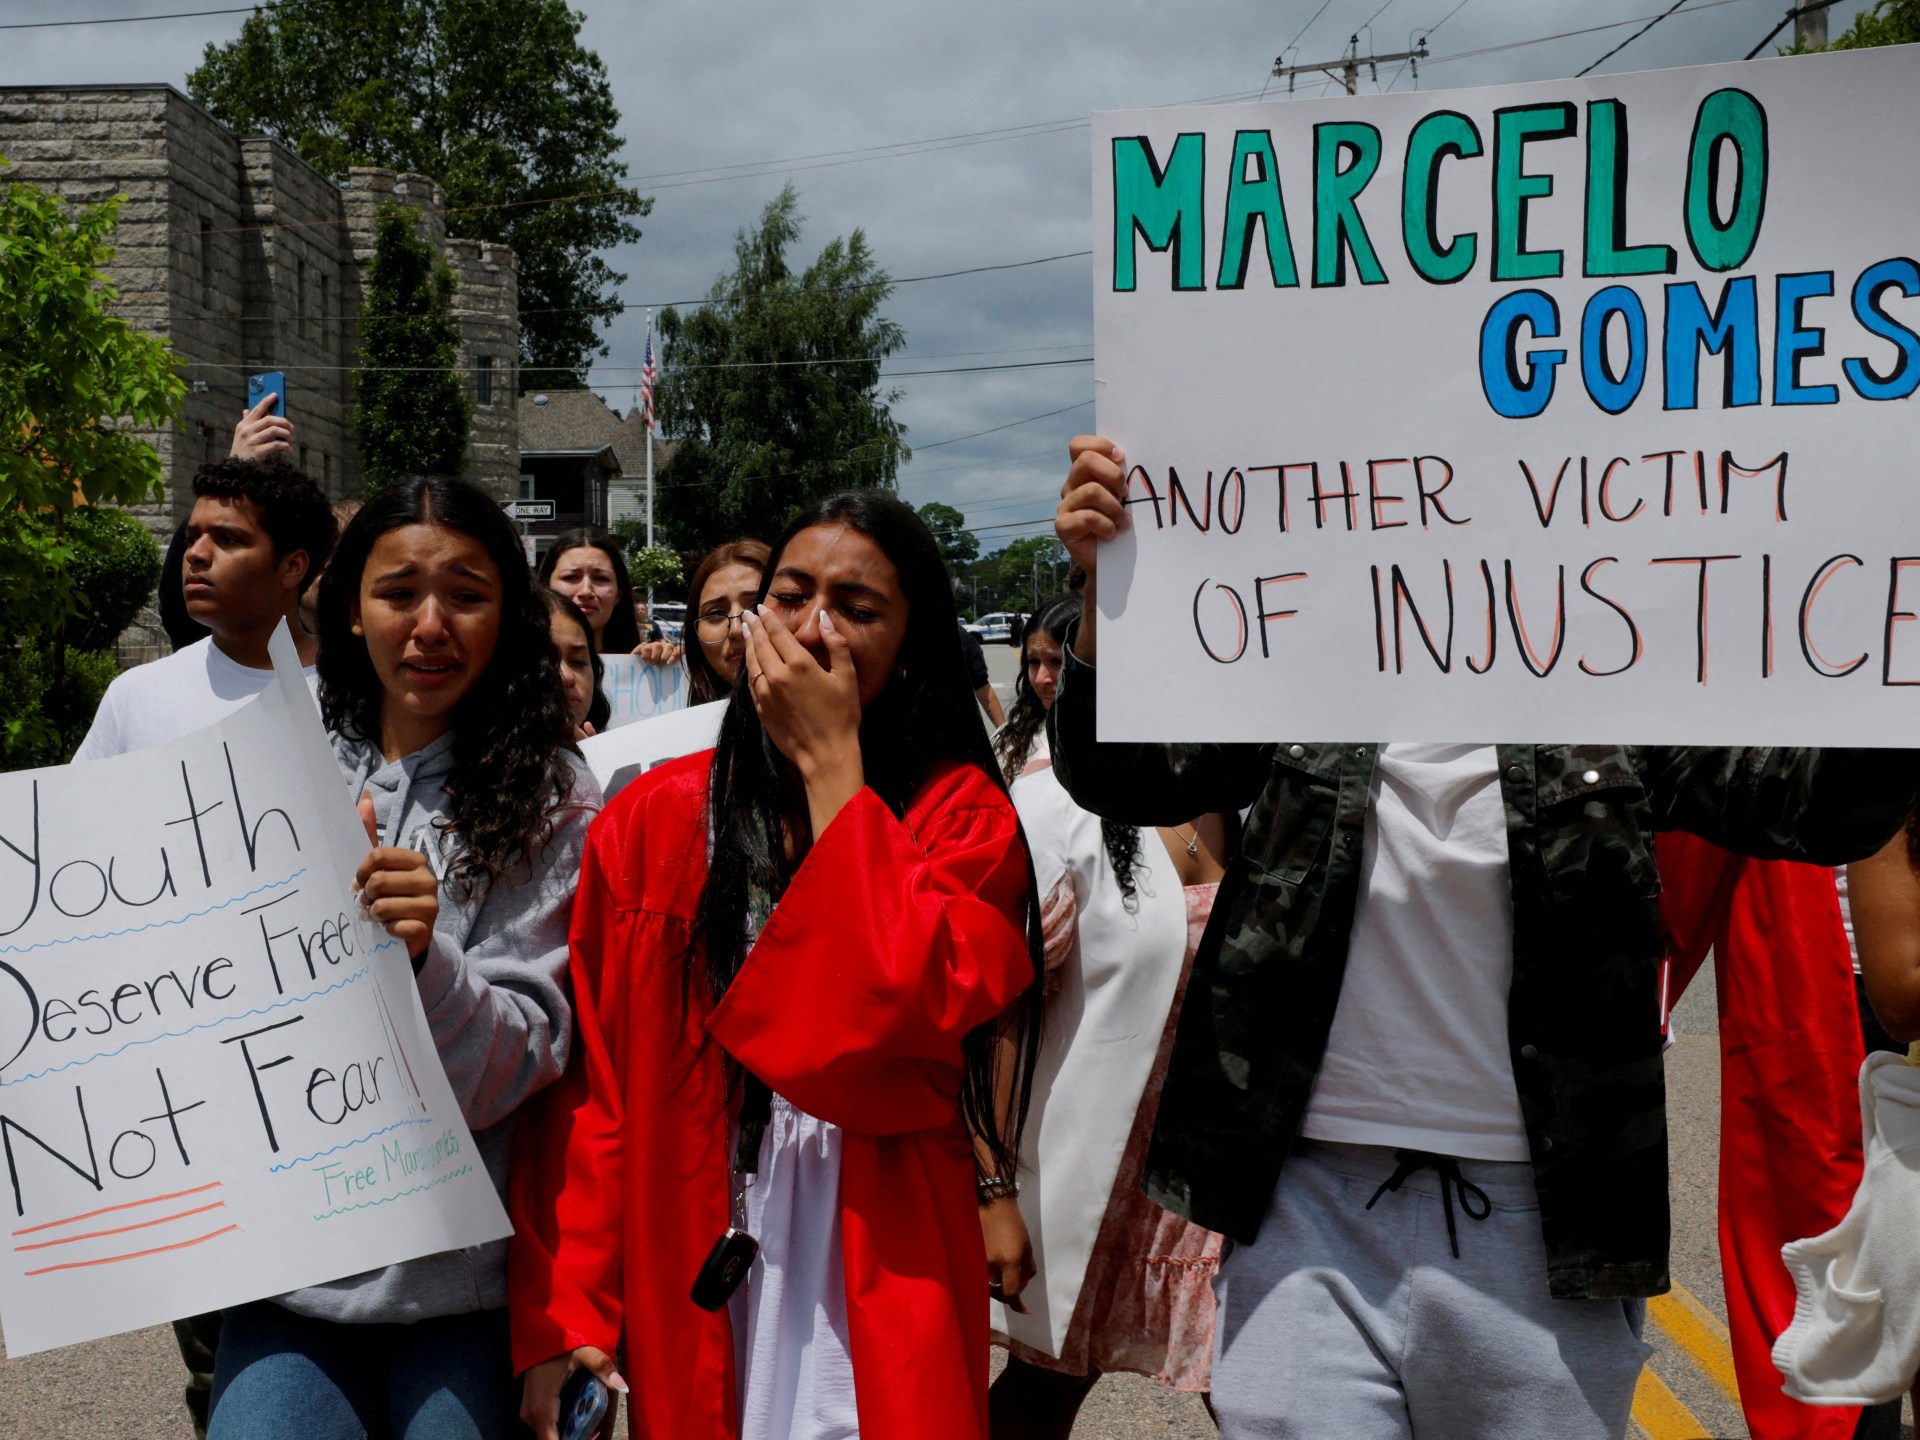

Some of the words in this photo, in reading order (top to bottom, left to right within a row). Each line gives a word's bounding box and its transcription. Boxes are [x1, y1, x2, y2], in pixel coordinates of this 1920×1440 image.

[1111, 86, 1769, 292] MARCELO
[1479, 256, 1920, 419] GOMES
[515, 506, 531, 515] ONE
[533, 506, 549, 515] WAY
[1121, 455, 1471, 536] ANOTHER
[1518, 449, 1789, 529] VICTIM
[1193, 572, 1309, 664] OF
[1370, 553, 1920, 687] INJUSTICE
[0, 1067, 206, 1217] Not
[312, 1161, 376, 1206] Free
